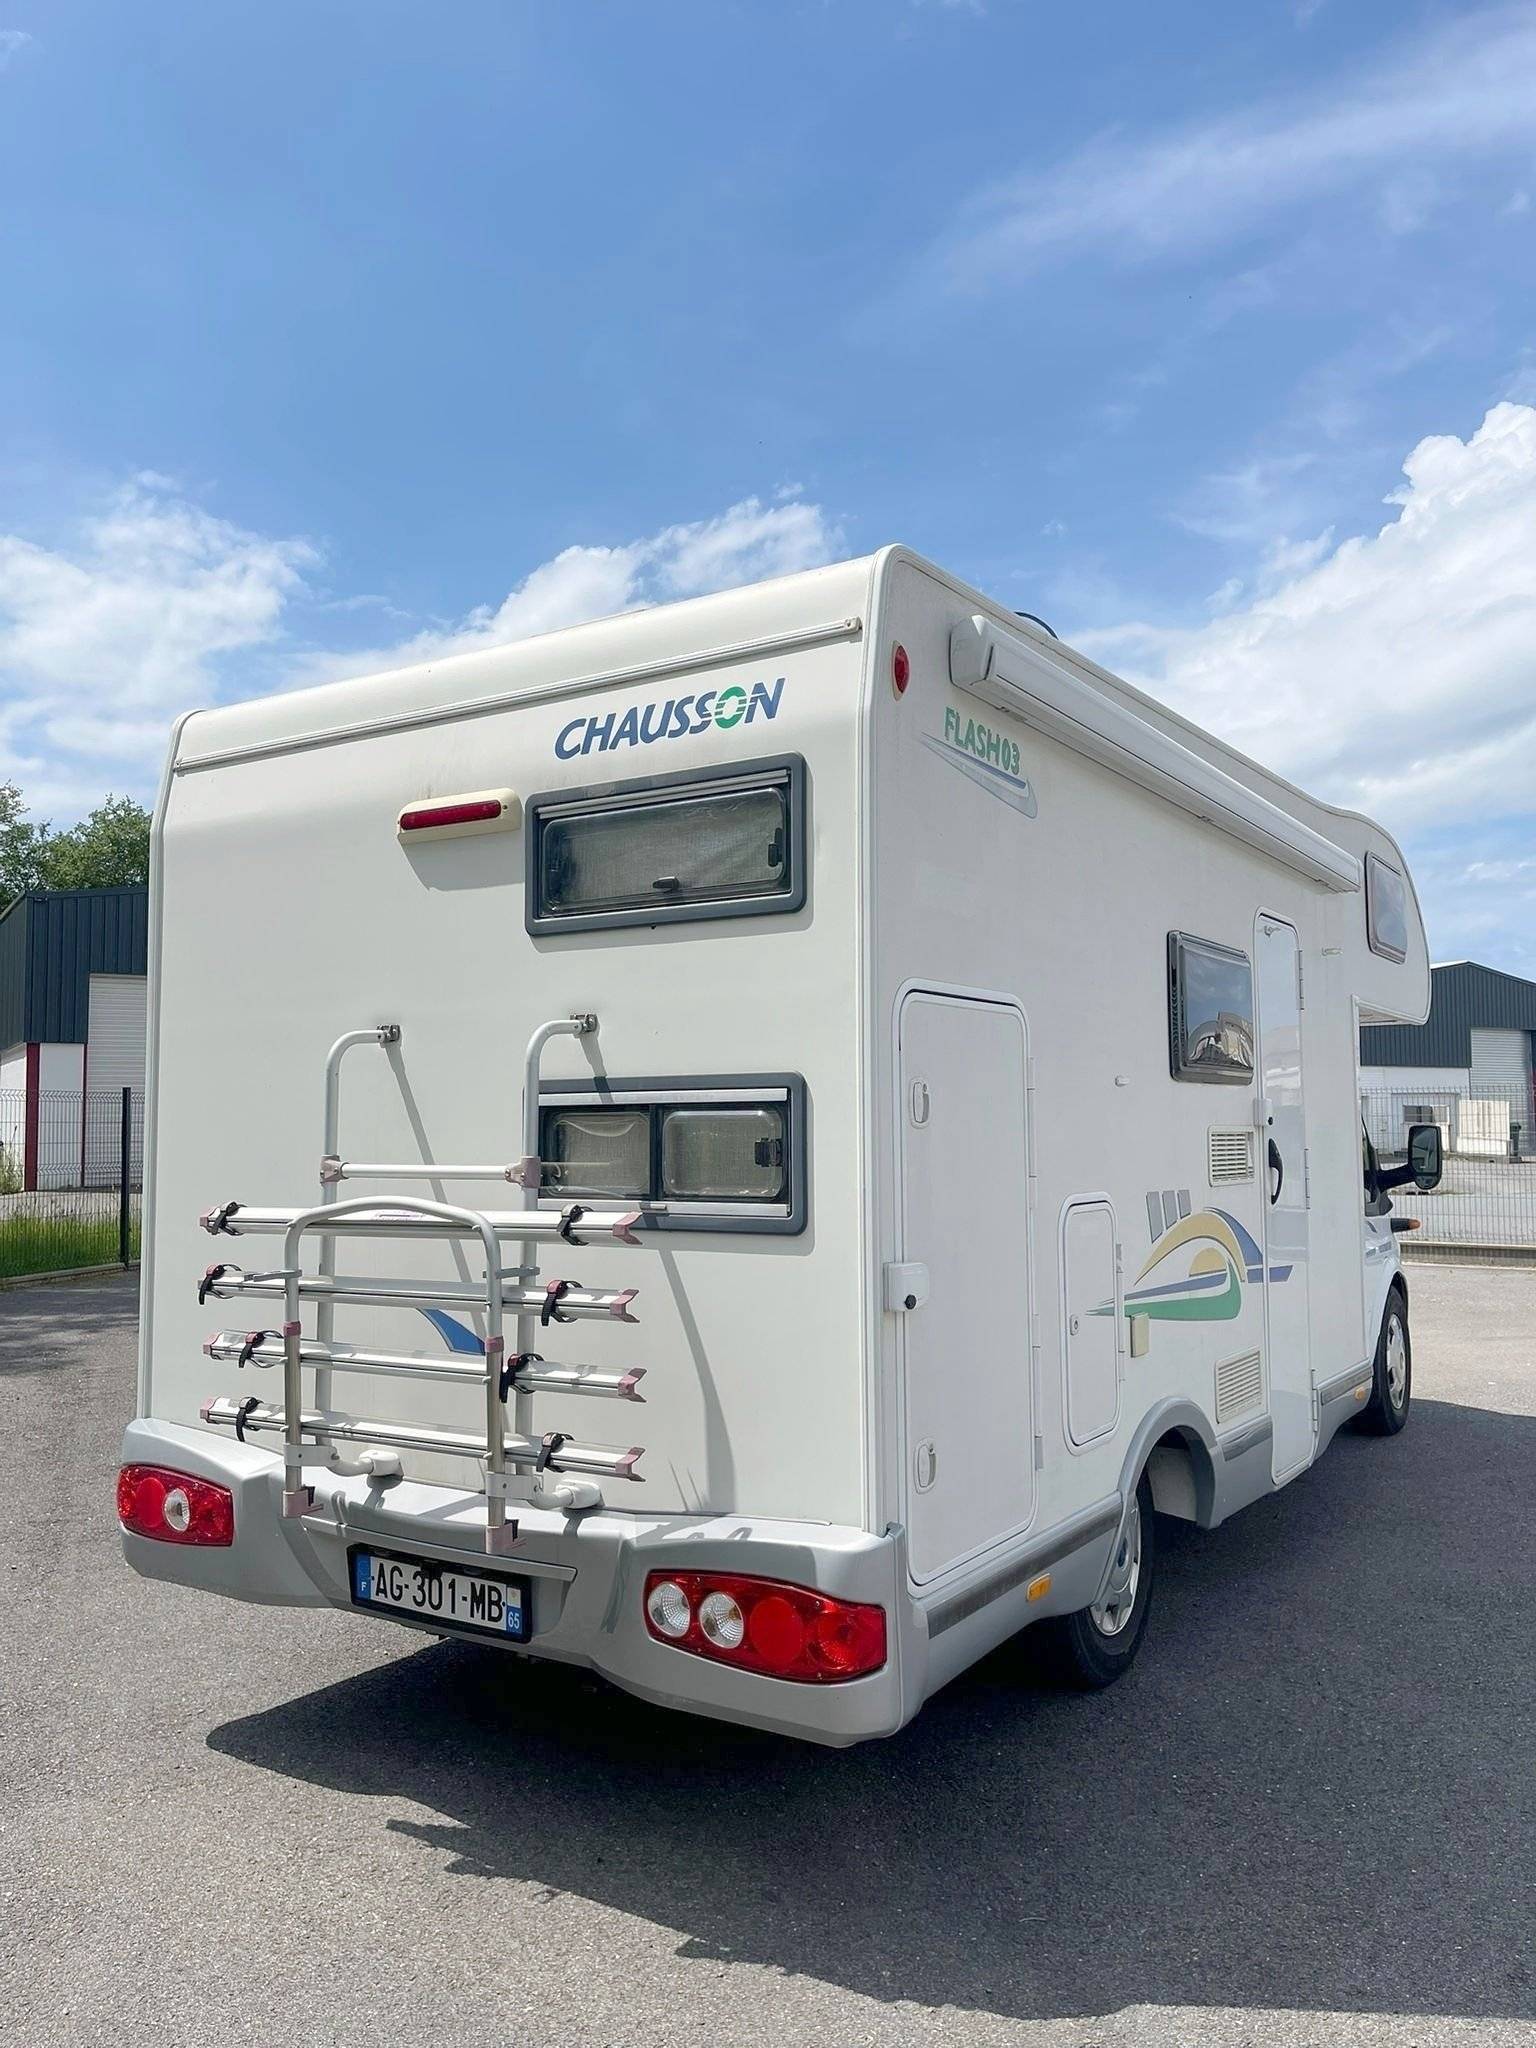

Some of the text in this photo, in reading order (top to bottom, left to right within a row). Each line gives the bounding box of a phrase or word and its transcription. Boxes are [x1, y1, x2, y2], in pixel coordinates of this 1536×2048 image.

[555, 677, 785, 760] CHAUSSON
[361, 1581, 367, 1592] F
[375, 1562, 504, 1623] AG-301-MB
[508, 1611, 520, 1630] 65
